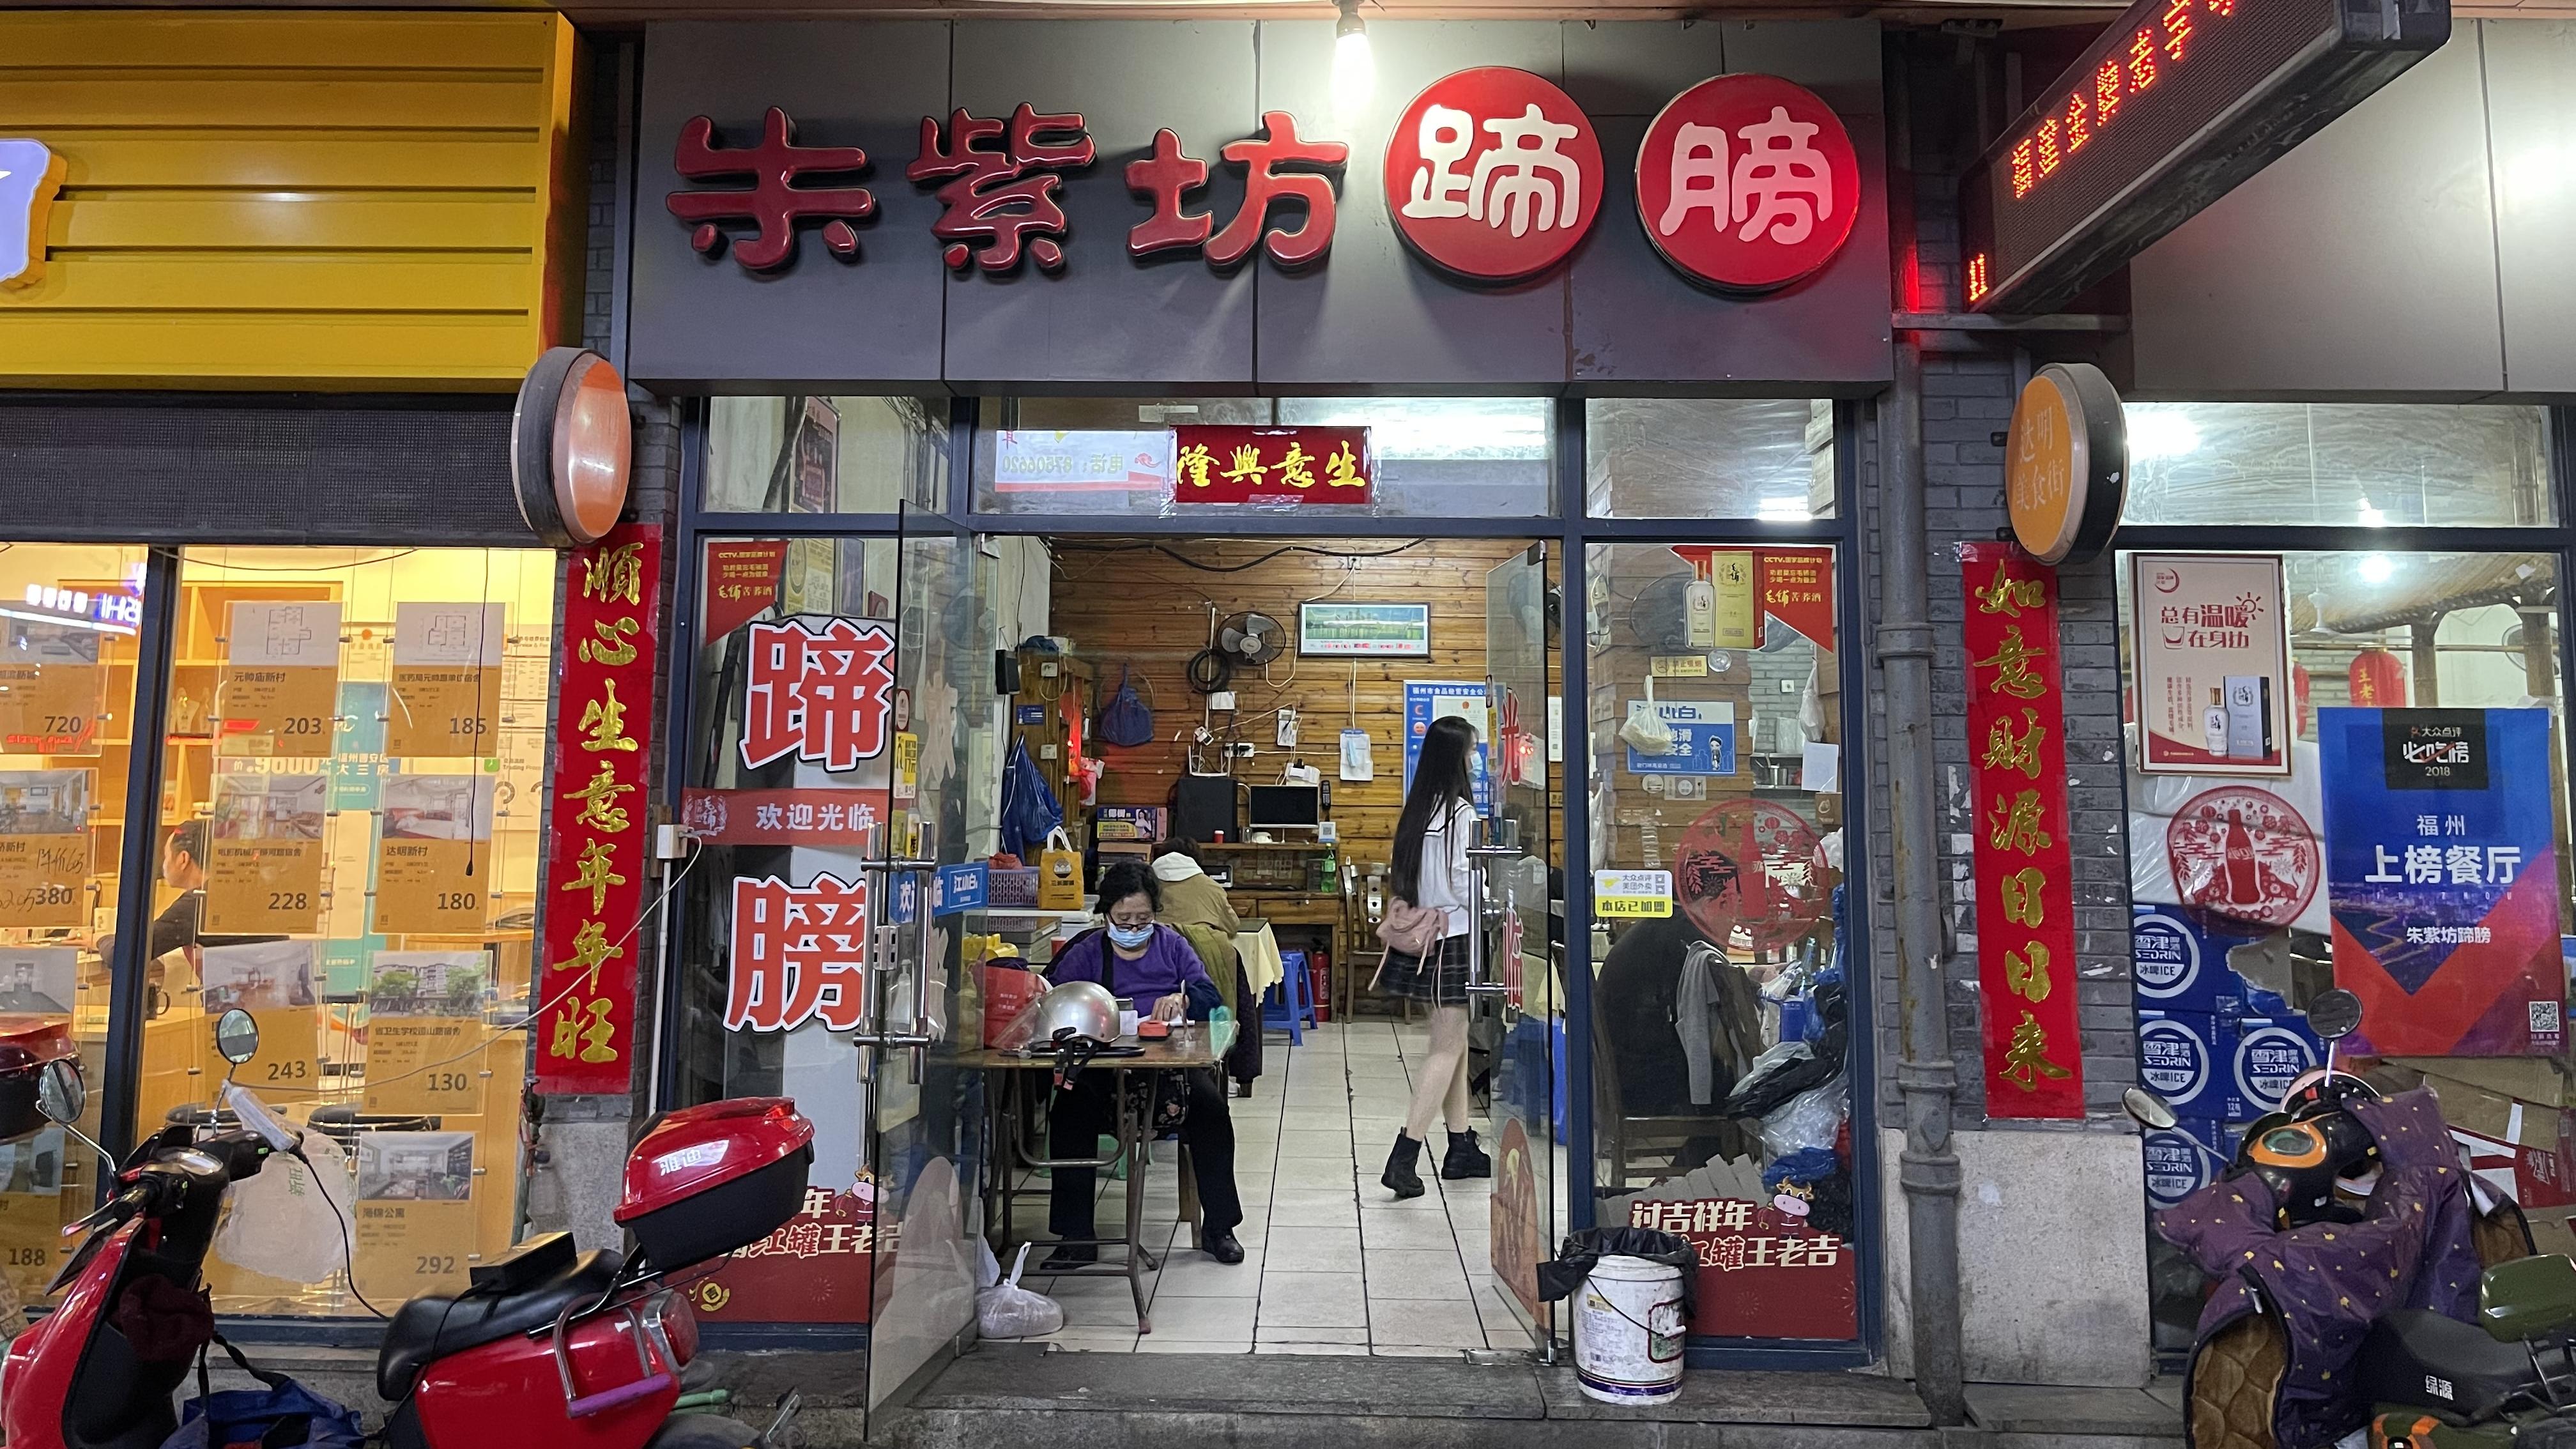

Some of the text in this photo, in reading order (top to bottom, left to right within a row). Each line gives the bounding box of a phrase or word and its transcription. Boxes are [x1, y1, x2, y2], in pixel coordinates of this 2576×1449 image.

[2011, 0, 2234, 199] 福建金牌老字
[2016, 459, 2065, 511] 美食街
[2161, 604, 2249, 628] 总有温暖
[2188, 630, 2250, 649] 在身边
[234, 672, 286, 683] 元帅庙新村
[2358, 668, 2374, 703] 王老
[1413, 687, 1487, 696] 福州市食品经营安全公
[44, 716, 82, 733] 720
[283, 717, 322, 735] 203
[449, 717, 487, 734] 185
[2421, 727, 2462, 737] 大众点评
[2403, 741, 2469, 763] 必吃榜
[2425, 766, 2450, 776] 2018
[756, 802, 876, 831] 欢迎光临
[2418, 815, 2465, 836] 福州
[386, 846, 428, 857] 达明新村
[2365, 845, 2521, 884] 上榜餐厅
[35, 887, 73, 905] 380
[268, 893, 307, 910] 228
[437, 893, 476, 910] 180
[1602, 900, 1666, 912] 本店已加盟
[2407, 927, 2492, 944] 朱紫坊蹄膀
[2135, 949, 2181, 961] SEDRIN
[267, 1061, 307, 1081] 243
[2144, 1056, 2191, 1068] SEDRIN
[2253, 1064, 2300, 1074] SEDRIN
[428, 1073, 468, 1091] 130
[660, 1149, 702, 1176] 雅迪
[2147, 1162, 2193, 1173] SEDRIN
[1632, 1200, 1755, 1233] 过吉祥年
[8, 1248, 45, 1266] 188
[415, 1256, 455, 1274] 292
